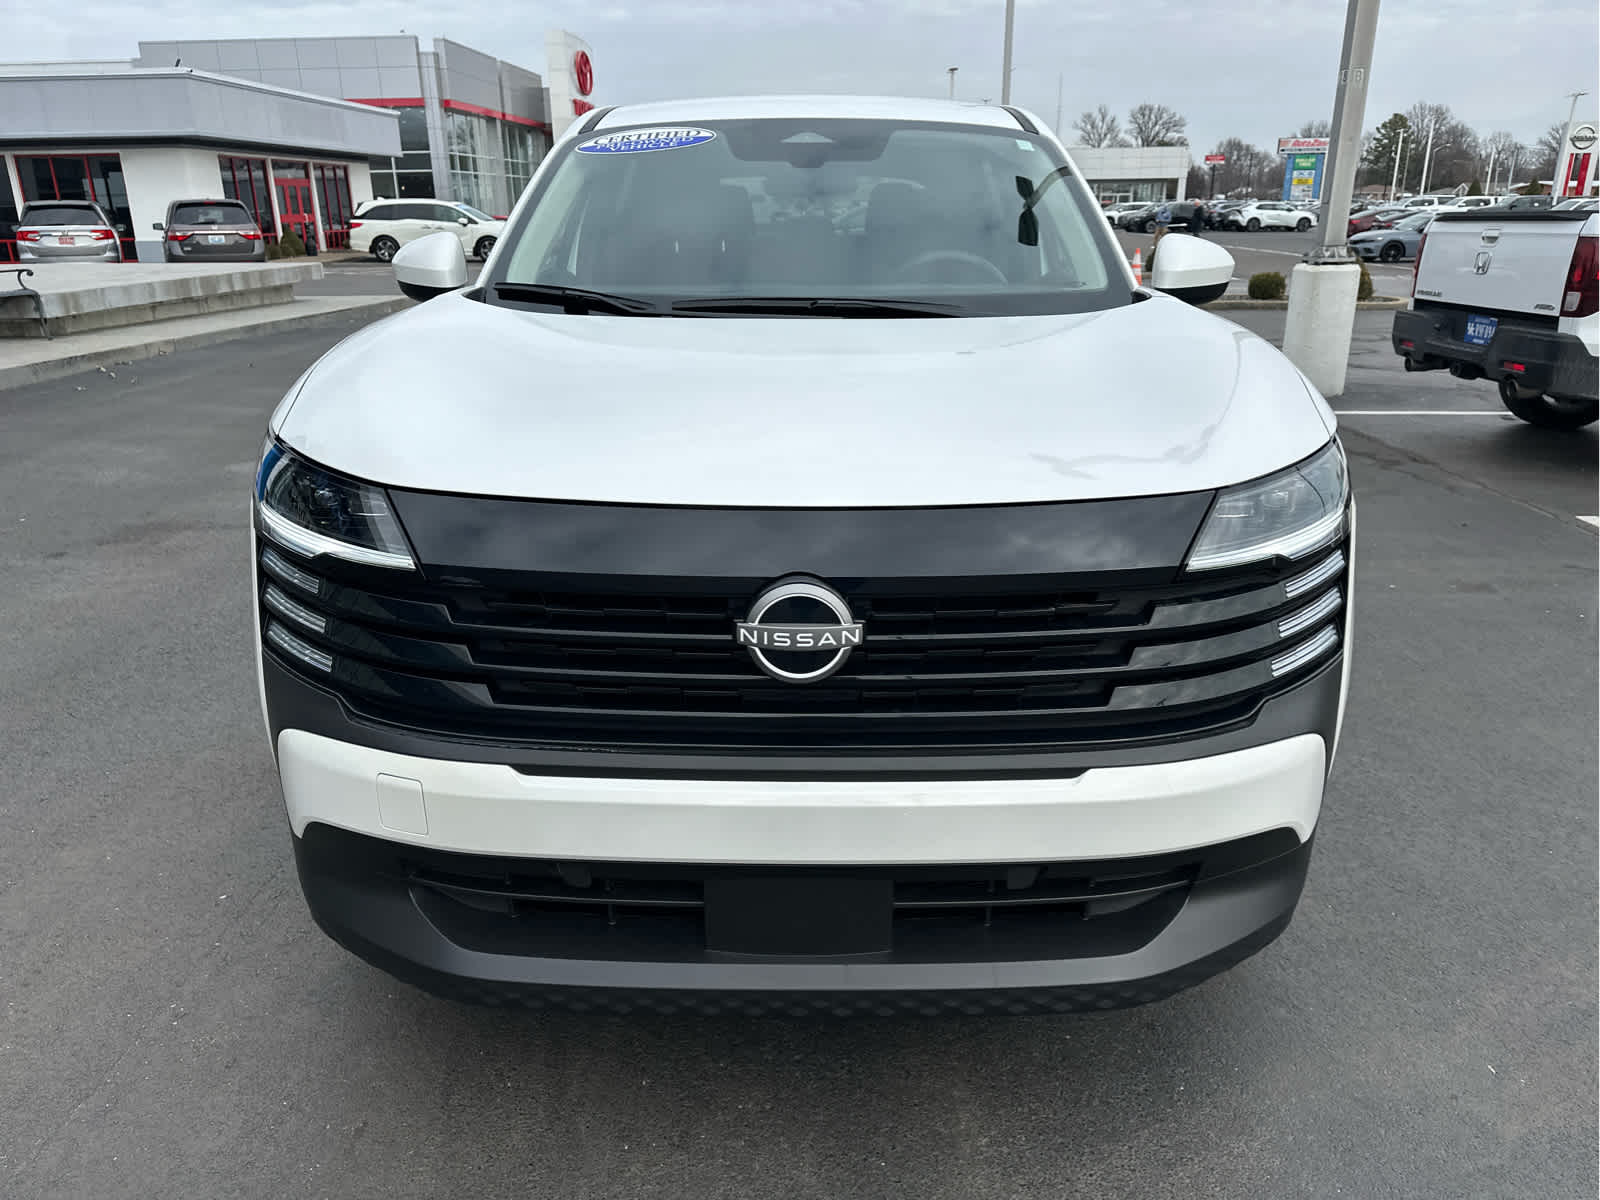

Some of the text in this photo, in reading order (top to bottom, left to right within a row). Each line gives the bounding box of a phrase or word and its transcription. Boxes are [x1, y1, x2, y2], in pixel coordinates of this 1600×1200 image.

[593, 130, 701, 145] CERTIFIED
[610, 141, 678, 151] VEHICLE
[740, 628, 860, 647] NISSAN
